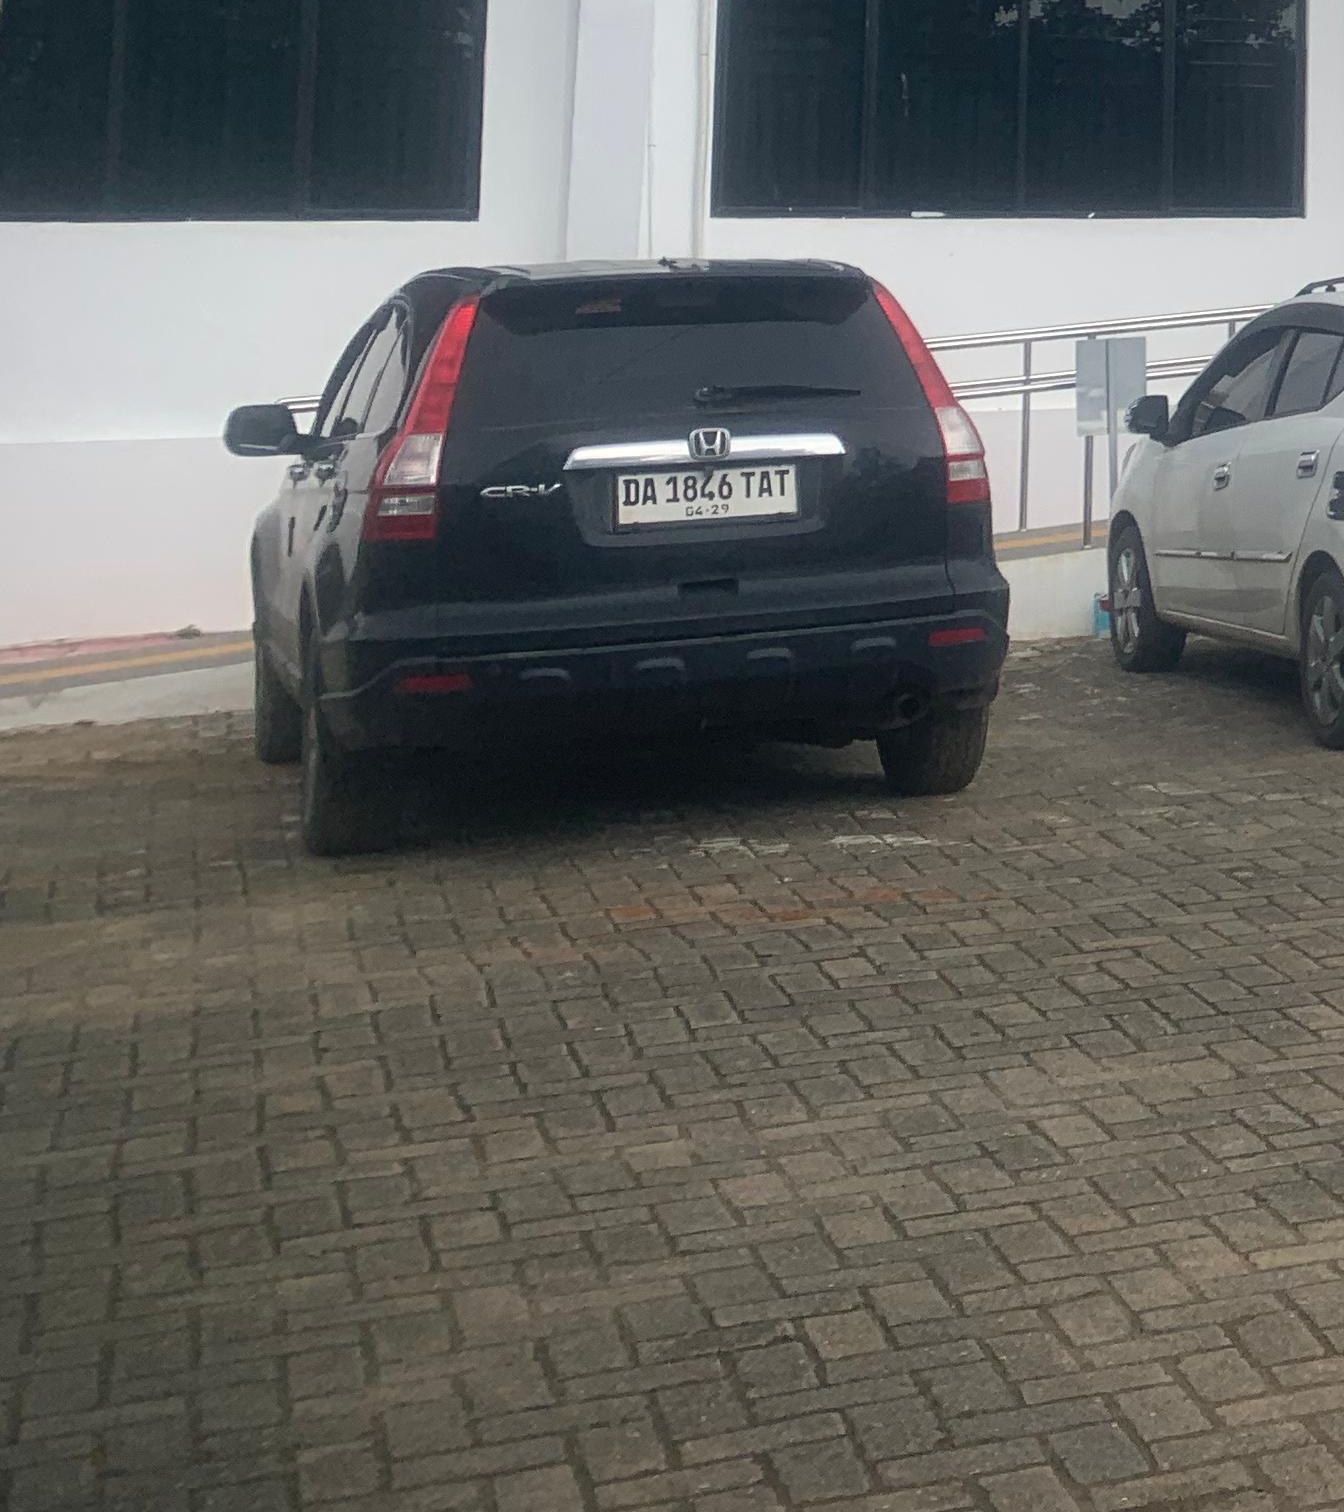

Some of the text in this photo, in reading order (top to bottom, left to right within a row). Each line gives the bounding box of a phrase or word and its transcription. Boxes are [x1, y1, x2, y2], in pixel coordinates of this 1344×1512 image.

[480, 483, 563, 498] CR-V
[622, 469, 789, 506] DA 1846 TAT
